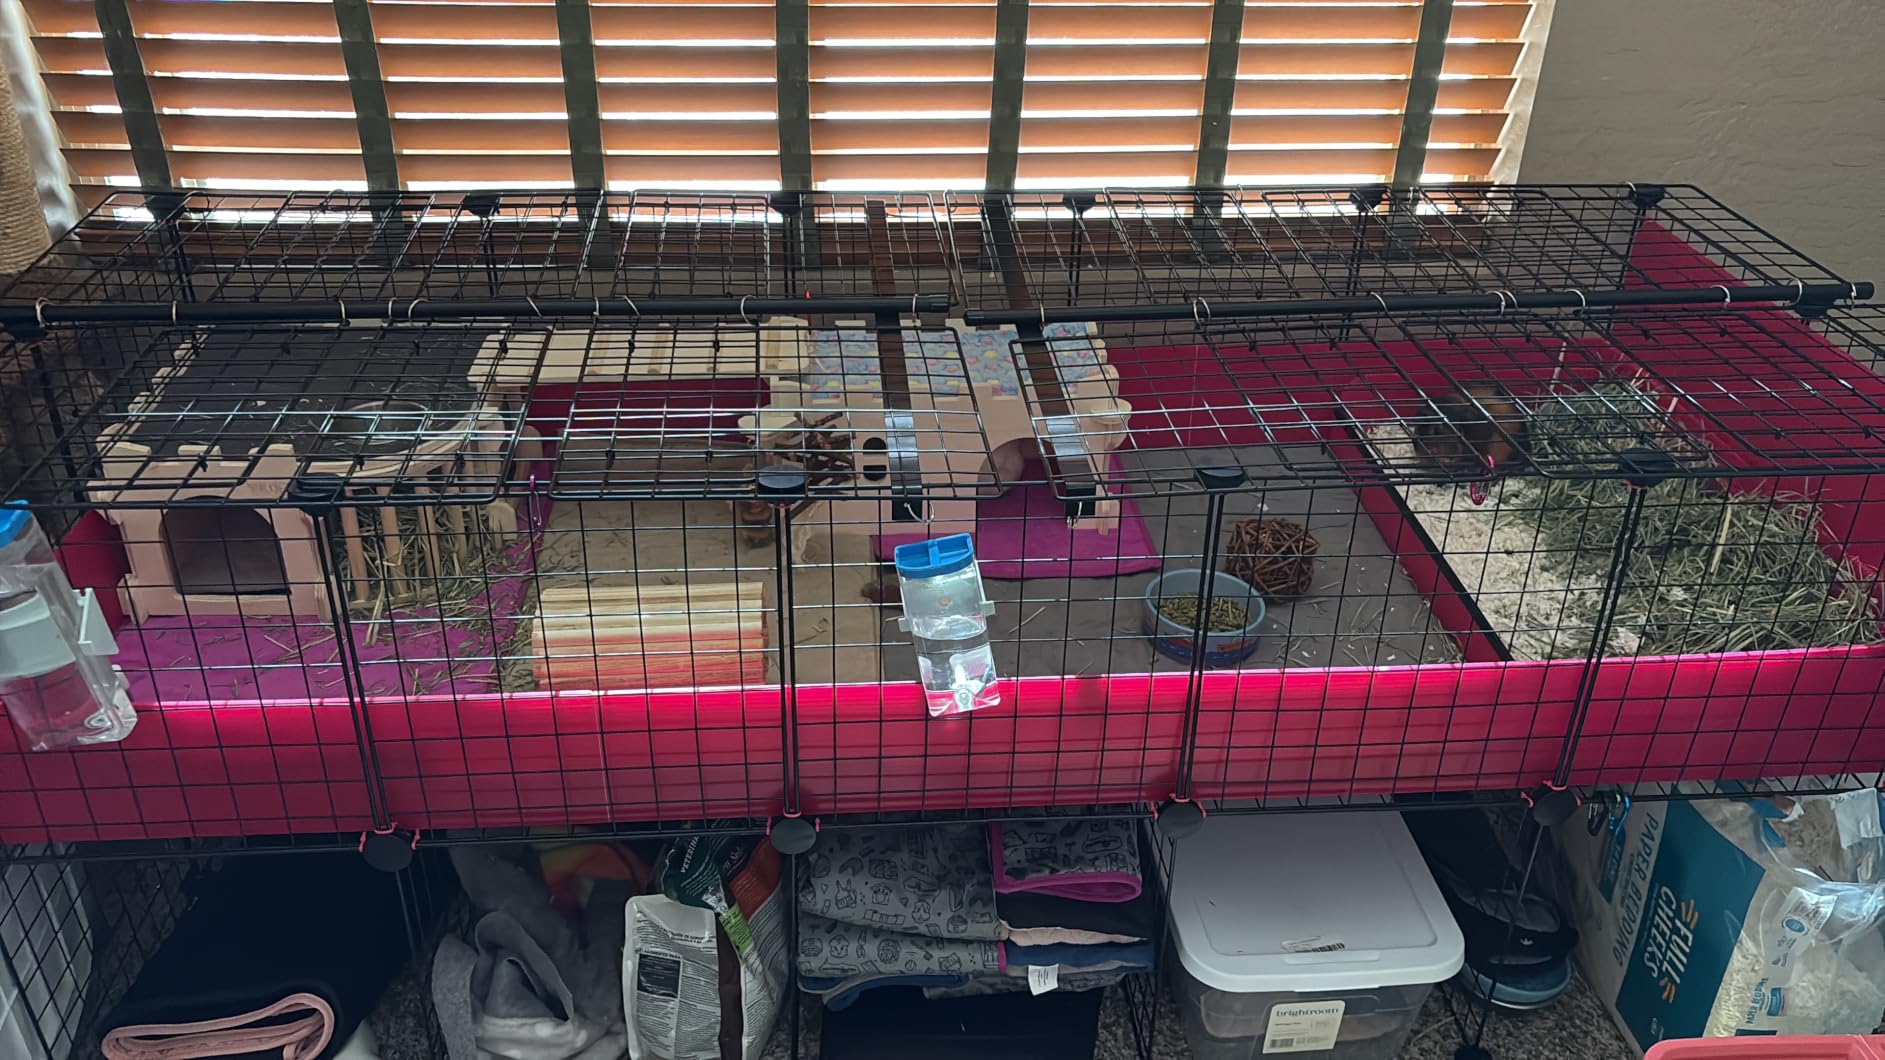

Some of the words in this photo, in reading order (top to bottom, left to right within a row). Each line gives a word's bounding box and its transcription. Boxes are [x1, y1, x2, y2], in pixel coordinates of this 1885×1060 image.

[1634, 812, 1659, 881] PAPER
[1612, 879, 1644, 968] BEDDING
[1643, 886, 1677, 978] CHEEKS
[1665, 918, 1694, 984] FULL
[1276, 1007, 1339, 1017] brightroom
